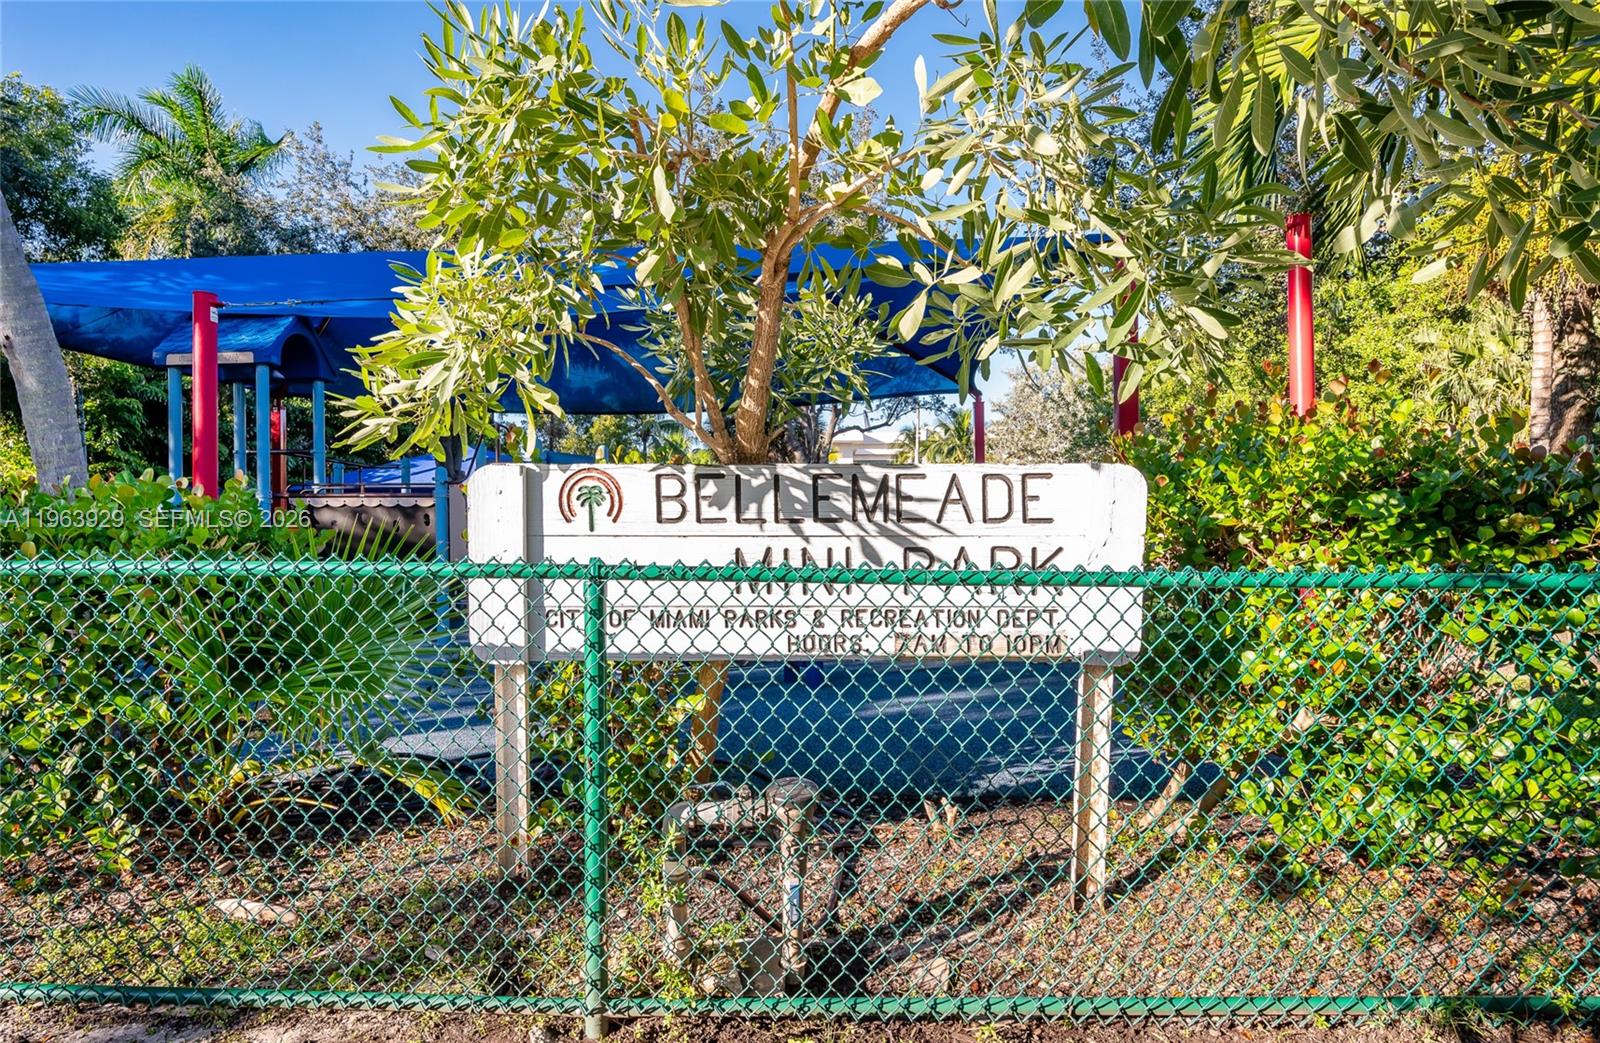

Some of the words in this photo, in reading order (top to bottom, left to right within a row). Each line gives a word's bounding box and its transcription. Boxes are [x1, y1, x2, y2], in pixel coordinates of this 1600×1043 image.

[655, 472, 1055, 525] BELLEMEADE
[734, 546, 852, 596] MINI
[902, 545, 1065, 597] PARK
[545, 608, 592, 629] CIT
[608, 608, 637, 629] OF
[649, 608, 711, 629] MIAMI
[724, 608, 798, 629] PARKS
[811, 608, 826, 629] &
[840, 608, 982, 629] RECREATION
[996, 608, 1061, 629] DEPT.
[962, 633, 993, 654] TO
[1006, 633, 1063, 654] 10PM
